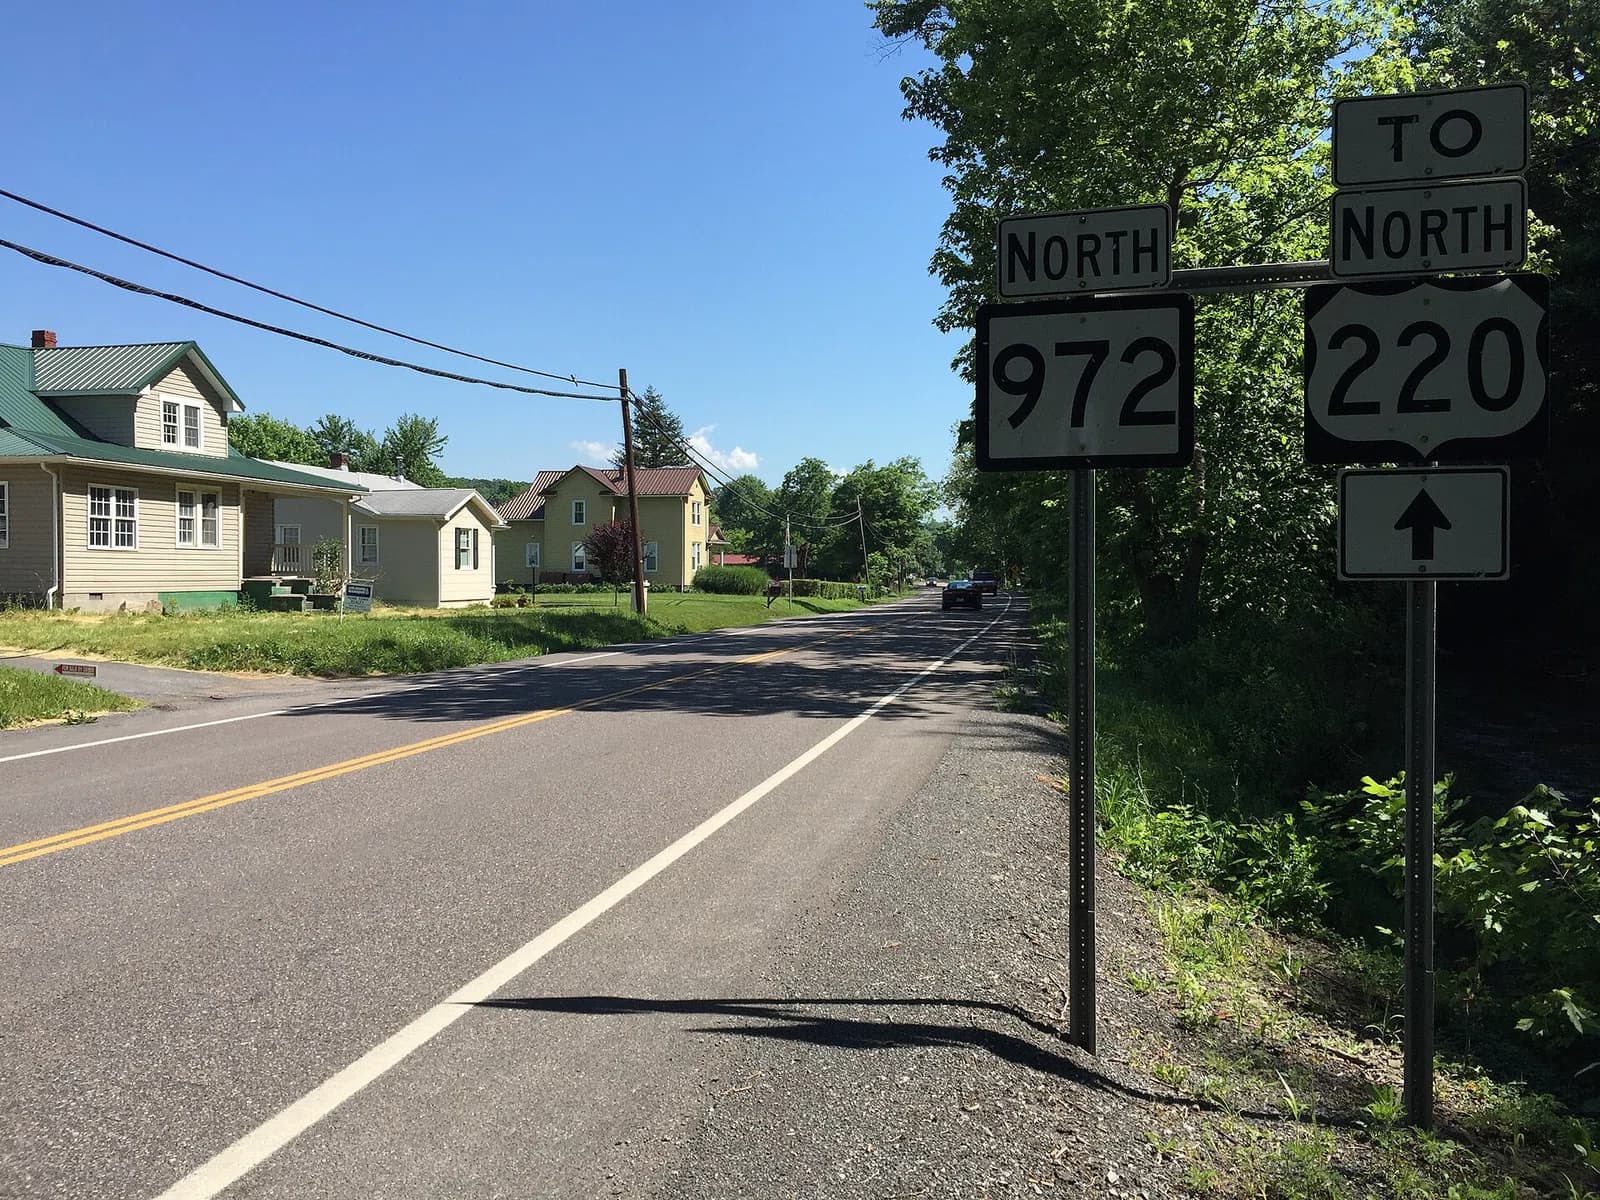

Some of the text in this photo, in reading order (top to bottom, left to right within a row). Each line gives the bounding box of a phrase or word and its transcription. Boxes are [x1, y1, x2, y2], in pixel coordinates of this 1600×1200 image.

[1377, 109, 1482, 162] TO
[1007, 227, 1160, 283] NORTH
[1342, 203, 1514, 262] NORTH
[992, 337, 1176, 430] 972
[1327, 317, 1526, 416] 220
